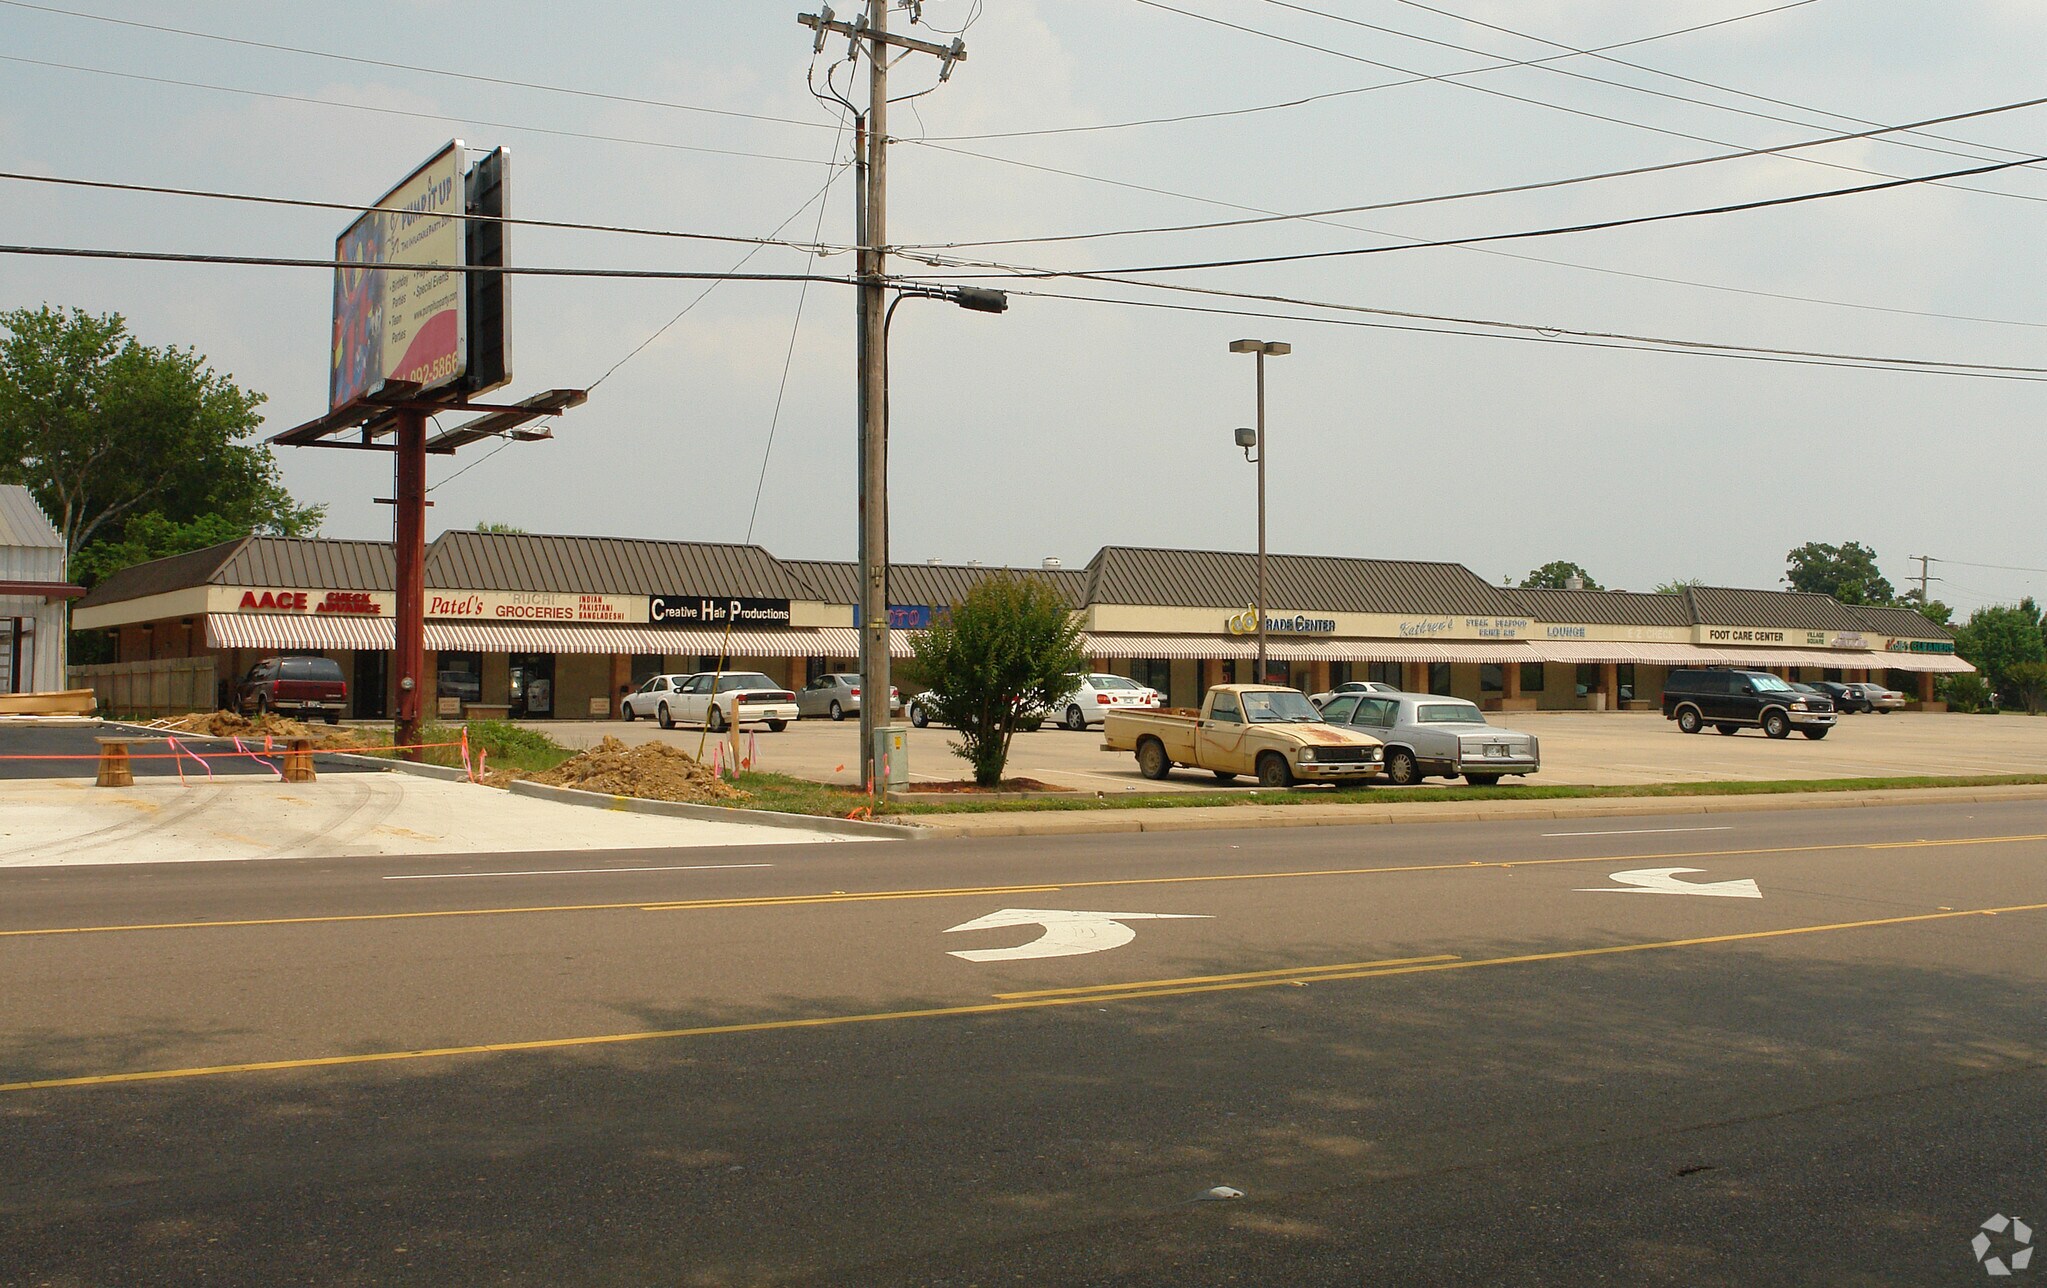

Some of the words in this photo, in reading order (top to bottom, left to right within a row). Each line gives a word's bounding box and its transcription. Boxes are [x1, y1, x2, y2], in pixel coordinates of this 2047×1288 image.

[438, 176, 452, 206] UP
[240, 591, 307, 609] AACE
[325, 592, 371, 603] CHECK
[513, 594, 556, 605] RUCHI
[578, 595, 603, 604] INDIAN
[316, 602, 380, 614] ADVANCE
[429, 595, 483, 615] Patel's
[578, 603, 613, 612] PAKISTANI
[651, 599, 698, 621] Creative
[701, 600, 727, 621] Hair
[730, 600, 789, 622] Productions
[495, 605, 573, 619] GROCERIES
[578, 611, 625, 620] BANGLADESHI
[1264, 614, 1293, 632] RADE
[1294, 614, 1336, 632] CENTER
[1465, 618, 1489, 627] STEAK
[1495, 619, 1528, 628] SEAFOOD
[1546, 626, 1586, 638] LOUNGE
[1709, 629, 1731, 640] FOOT
[1732, 630, 1753, 641] CARE
[1754, 631, 1784, 642] CENTER
[1910, 641, 1955, 652] CLEANERS
